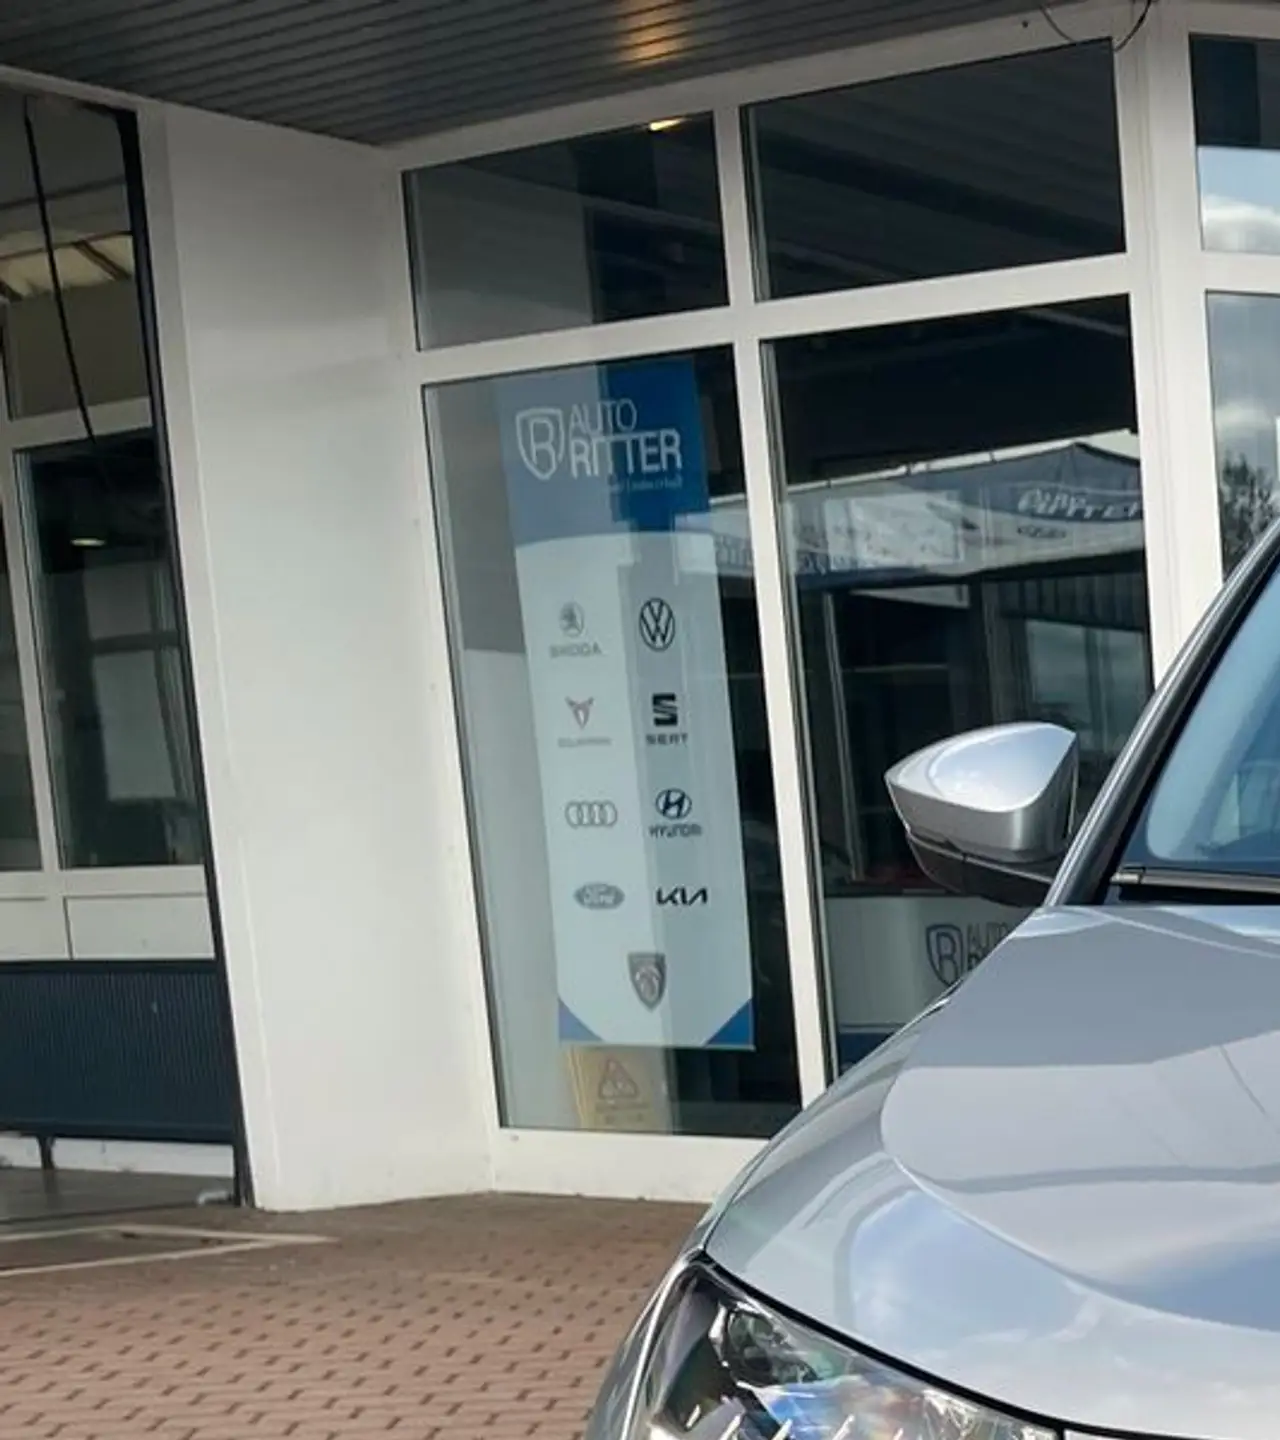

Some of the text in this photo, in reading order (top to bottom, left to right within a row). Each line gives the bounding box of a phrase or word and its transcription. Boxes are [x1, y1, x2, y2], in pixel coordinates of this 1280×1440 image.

[569, 398, 638, 434] AUTO
[569, 429, 683, 480] RITTER
[656, 887, 708, 906] KIA
